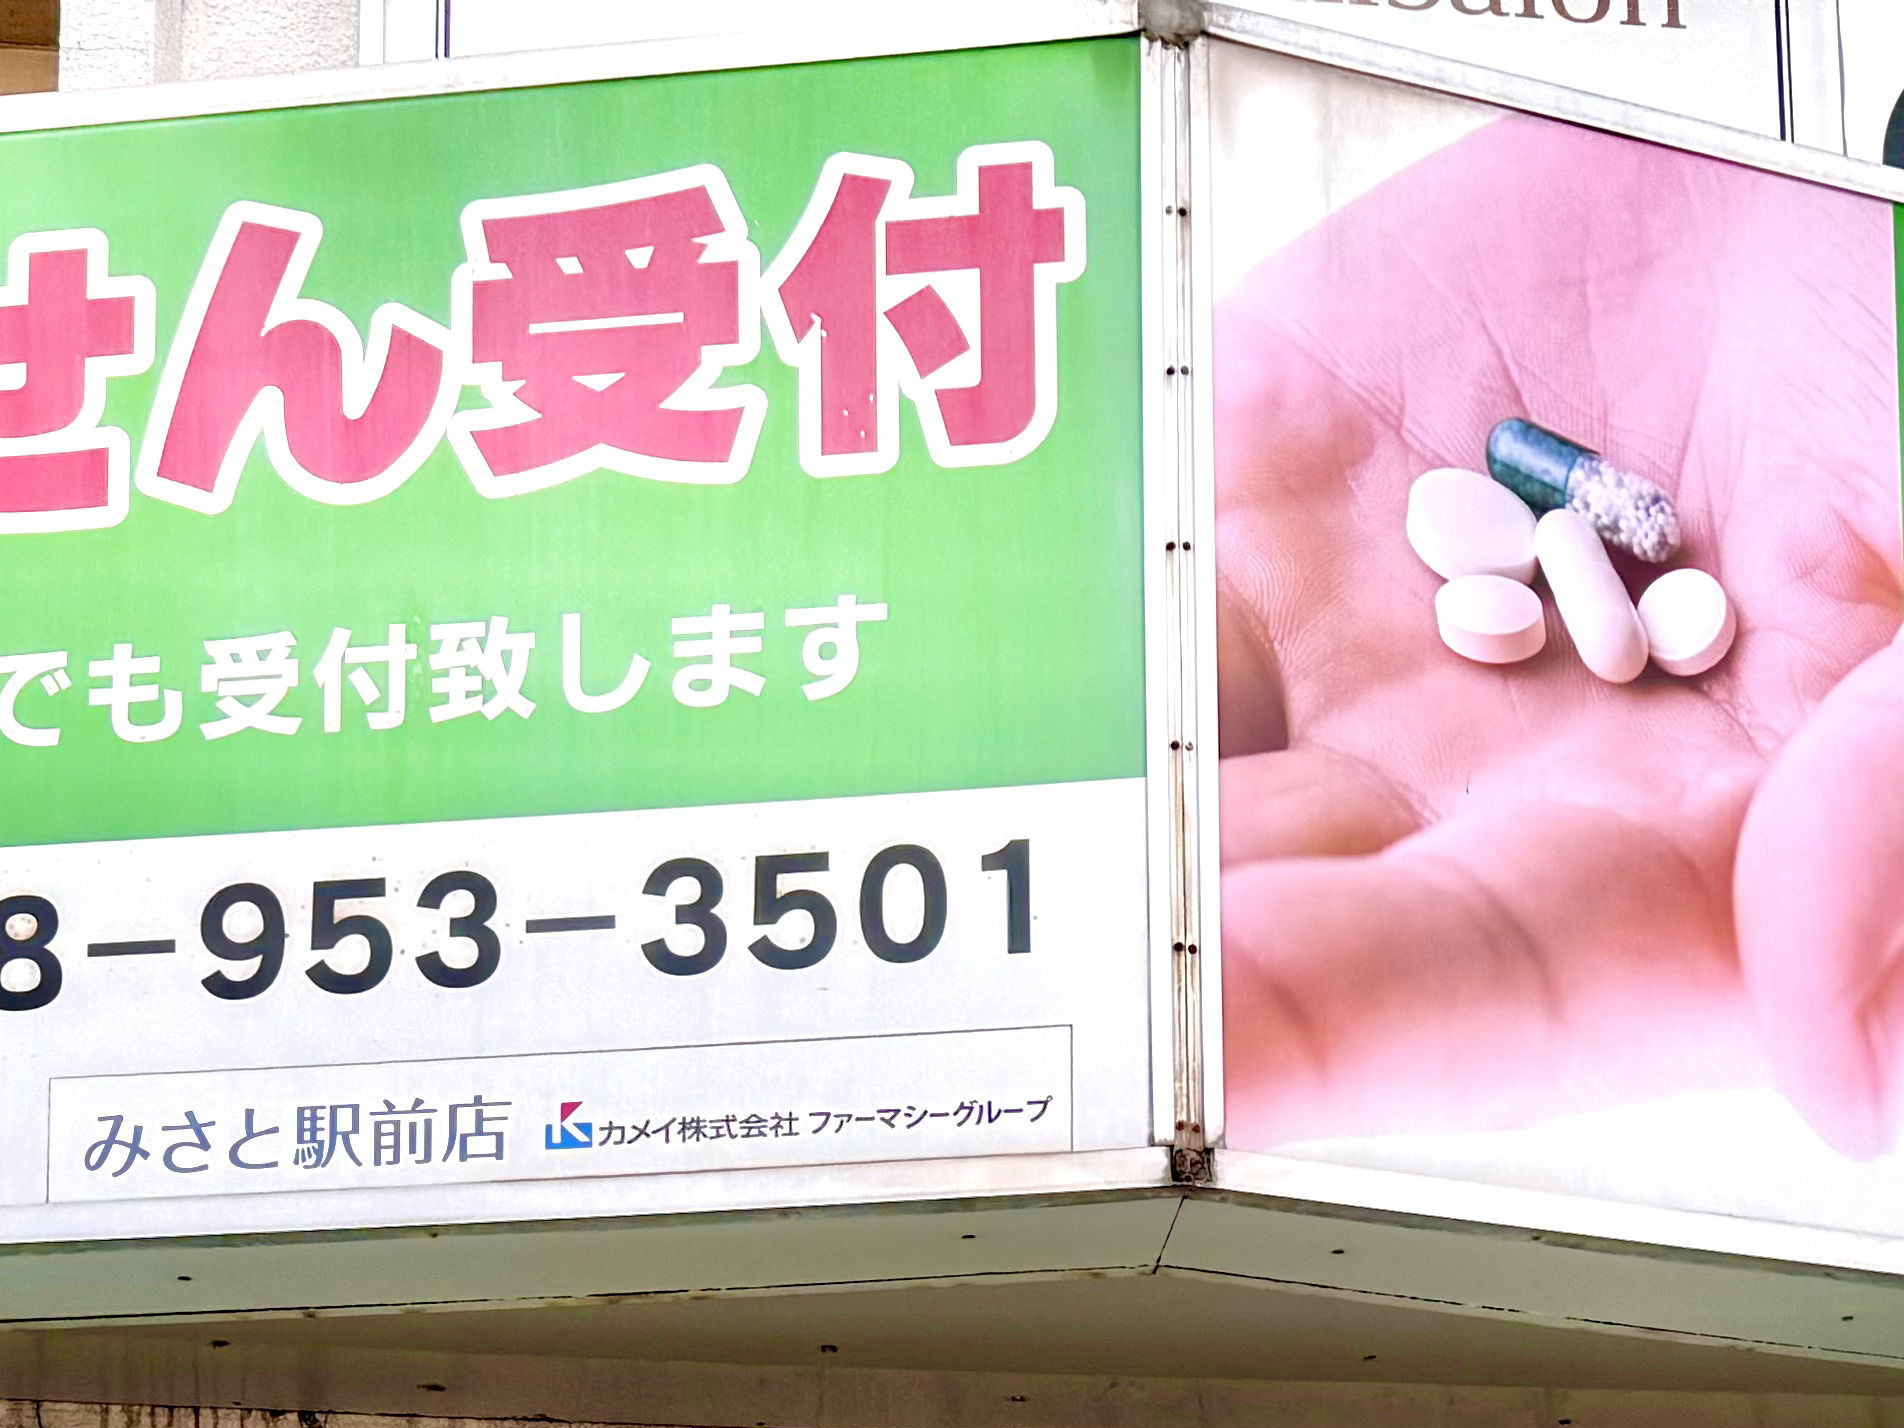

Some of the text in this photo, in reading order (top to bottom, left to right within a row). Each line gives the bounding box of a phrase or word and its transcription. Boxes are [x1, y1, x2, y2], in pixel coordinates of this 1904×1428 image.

[84, 1096, 509, 1179] みさと駅前店
[596, 1108, 801, 1147] カメイ株式会社
[807, 1095, 1053, 1133] ファーマシーグループ
